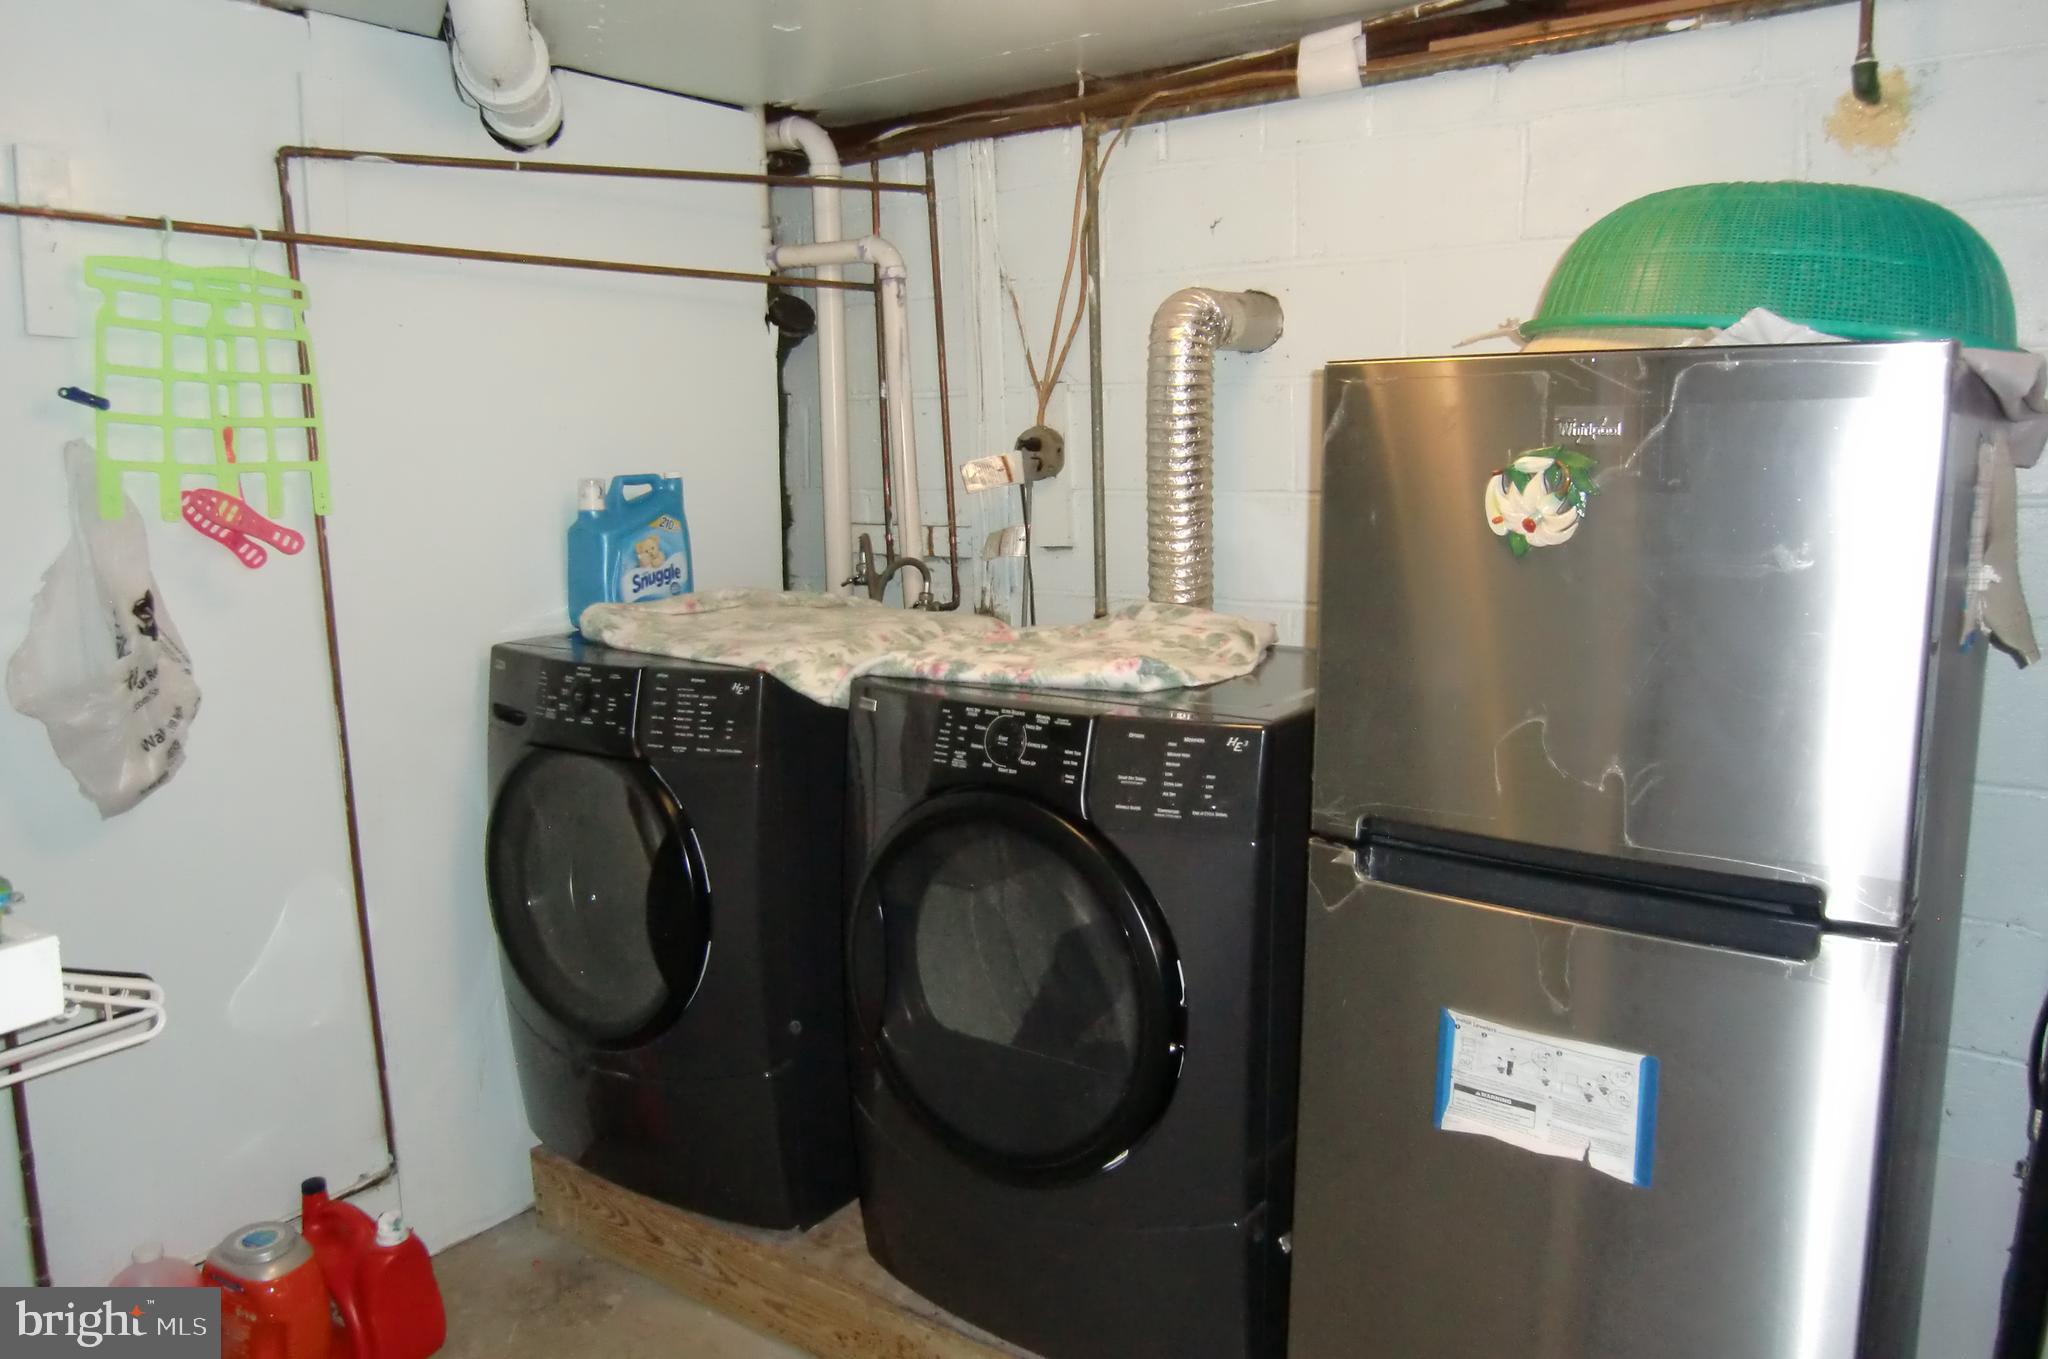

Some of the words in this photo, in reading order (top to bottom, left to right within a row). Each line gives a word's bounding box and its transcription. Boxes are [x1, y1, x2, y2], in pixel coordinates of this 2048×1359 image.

[1555, 417, 1623, 442] Whirlpool
[659, 517, 675, 530] 210
[632, 564, 681, 594] Snuggle
[1481, 1091, 1512, 1105] WARNING
